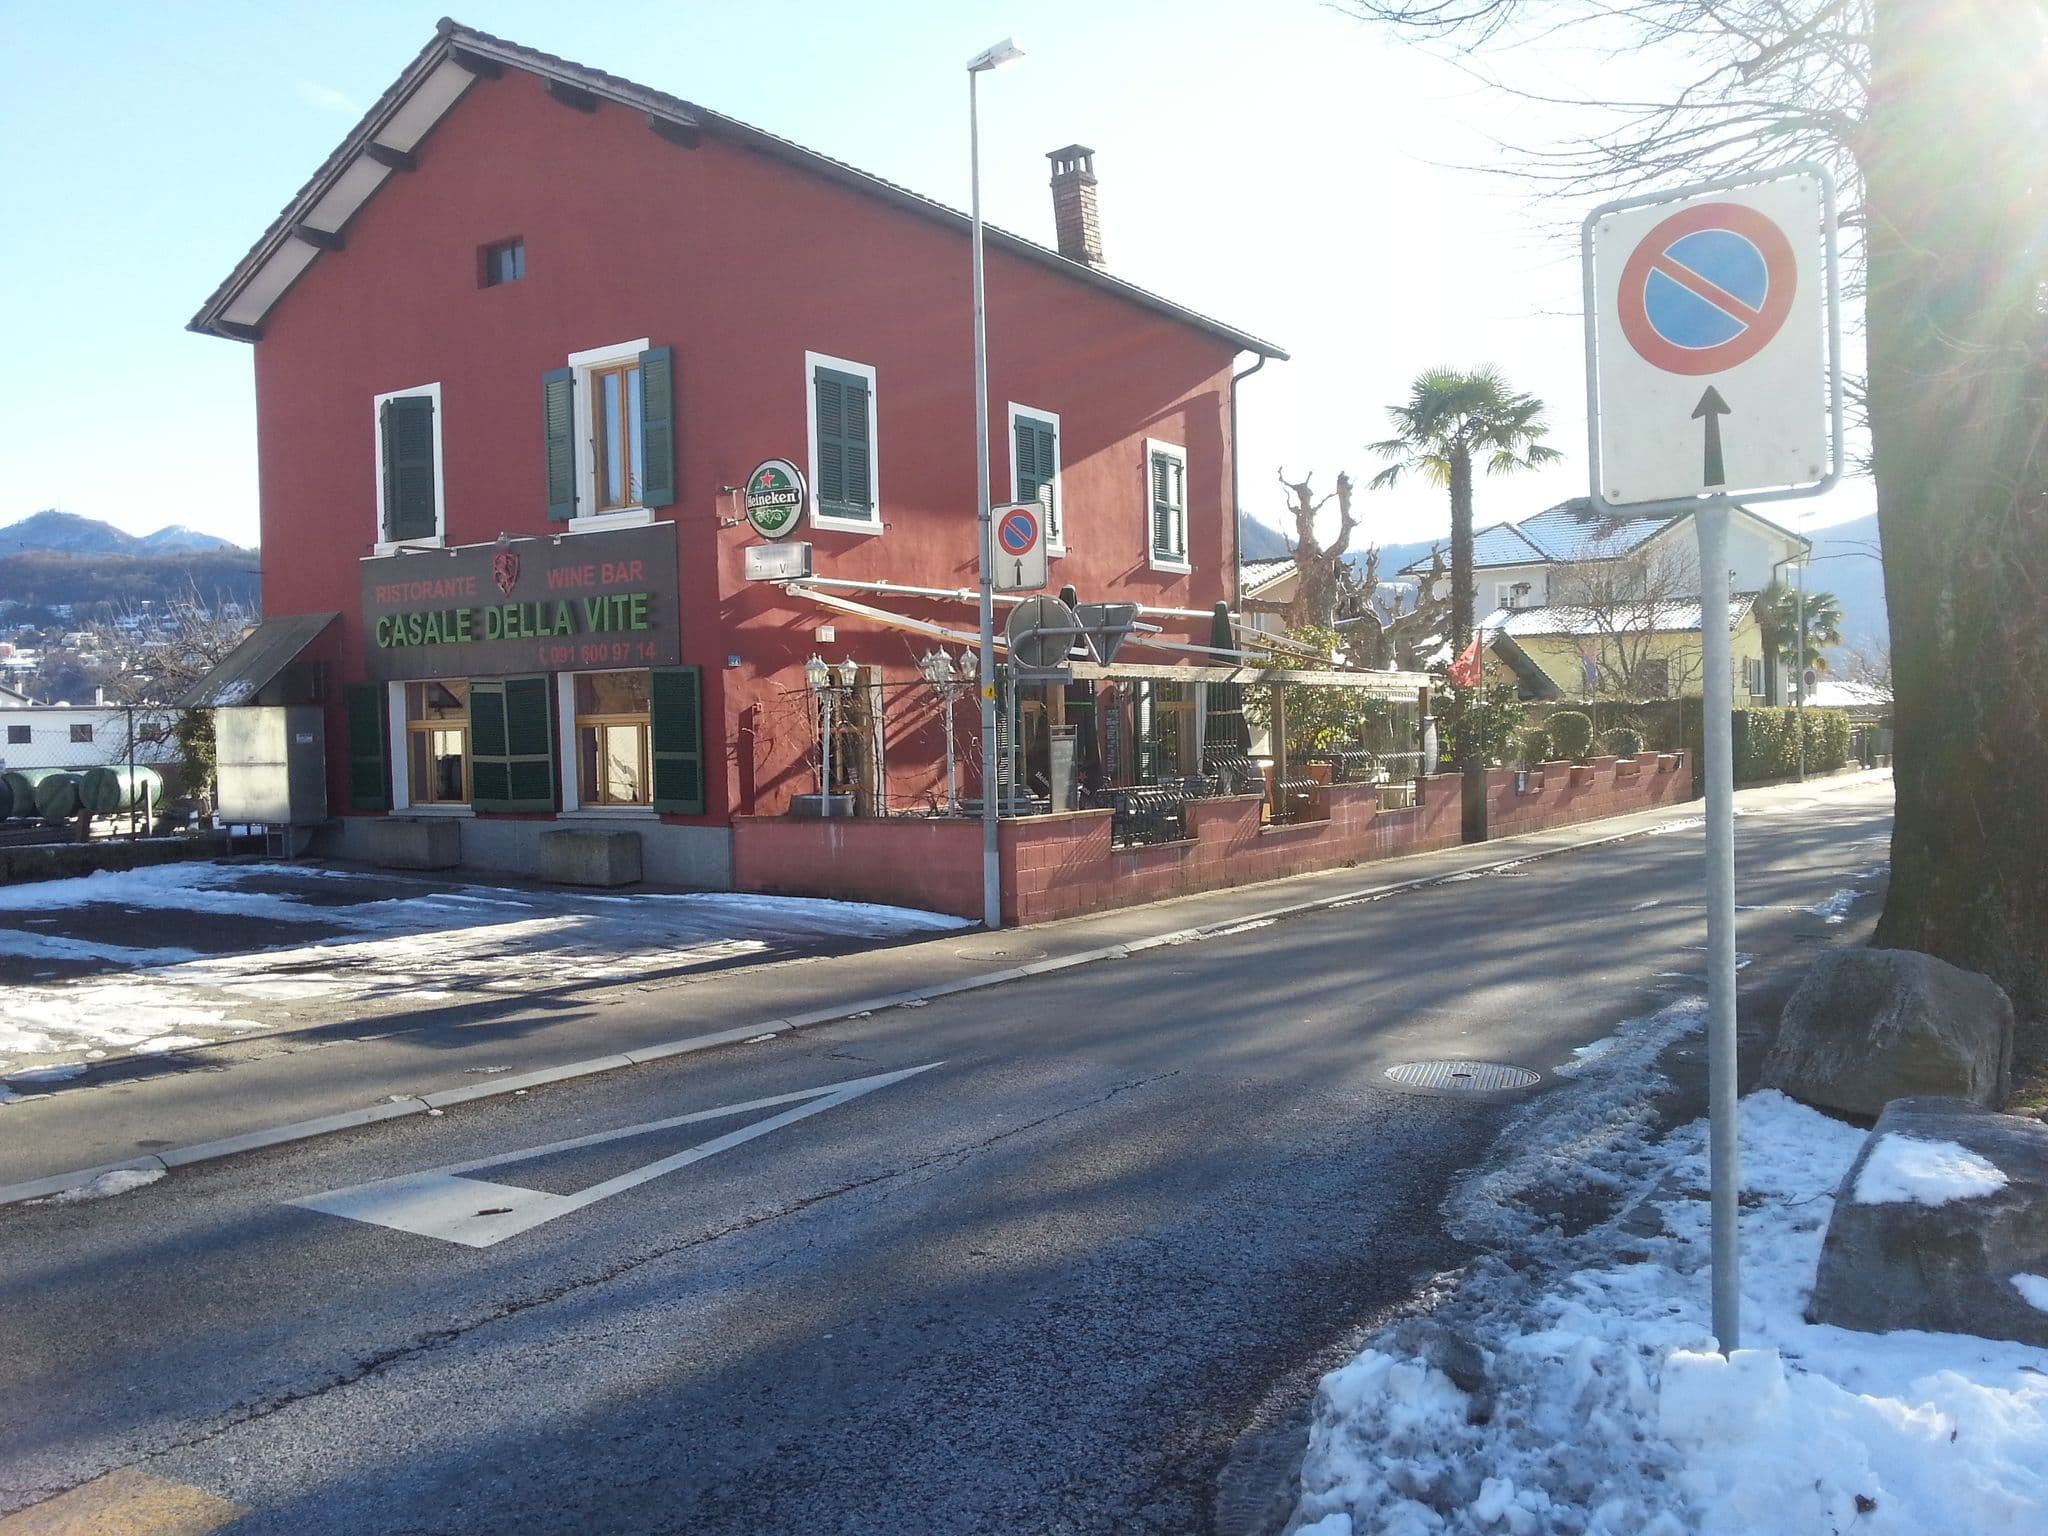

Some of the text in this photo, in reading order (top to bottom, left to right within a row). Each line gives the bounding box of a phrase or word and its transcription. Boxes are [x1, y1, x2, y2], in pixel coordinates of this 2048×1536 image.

[747, 491, 796, 507] Heineken
[375, 575, 478, 604] RISTORANTE
[547, 560, 644, 591] WINE BAR
[375, 593, 648, 648] CASALE DELLA VITE
[550, 645, 576, 665] 091
[612, 641, 631, 660] 97
[637, 639, 657, 660] 14
